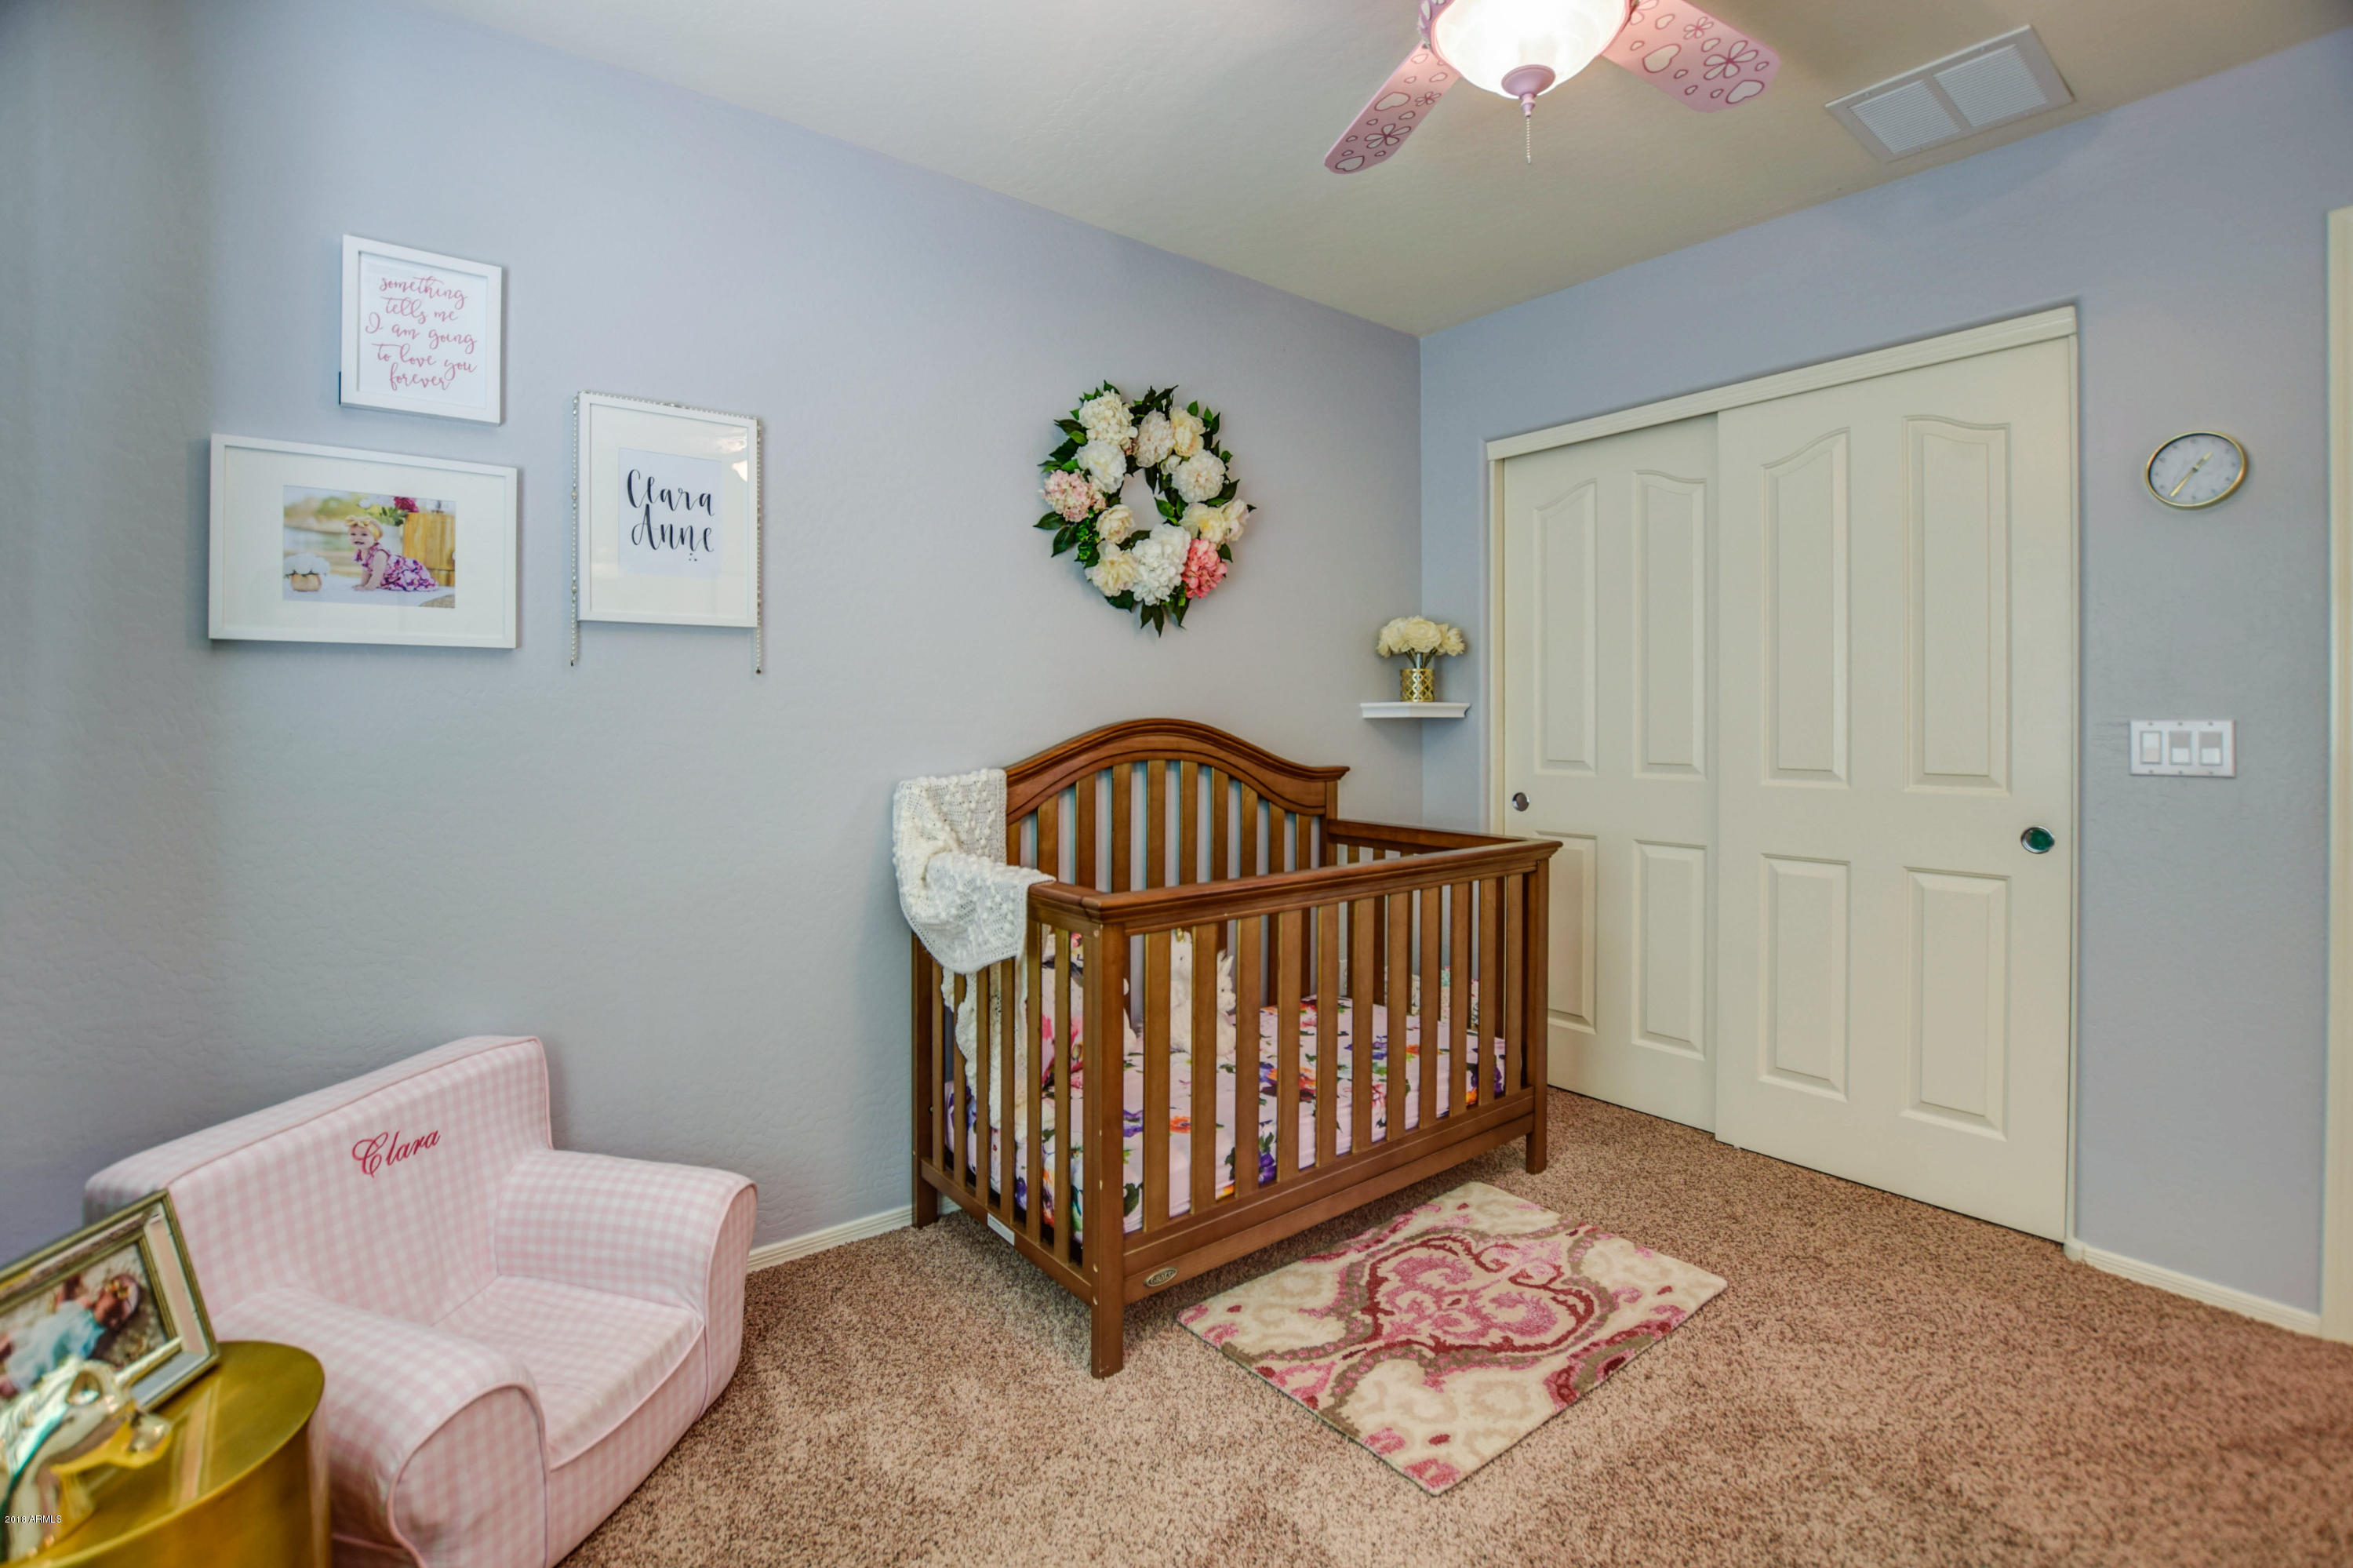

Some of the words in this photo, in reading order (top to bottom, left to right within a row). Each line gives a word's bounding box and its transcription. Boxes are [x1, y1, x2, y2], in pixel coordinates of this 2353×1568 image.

[379, 275, 468, 310] something
[380, 296, 427, 325] tells
[434, 310, 458, 322] me
[365, 311, 383, 334] I
[391, 324, 420, 340] am
[428, 329, 477, 355] going
[371, 343, 394, 362] to
[399, 343, 436, 368] love
[443, 358, 477, 381] you
[390, 362, 451, 391] forever
[627, 469, 715, 517] Clara
[631, 504, 715, 553] Anne
[351, 1130, 441, 1179] Clara
